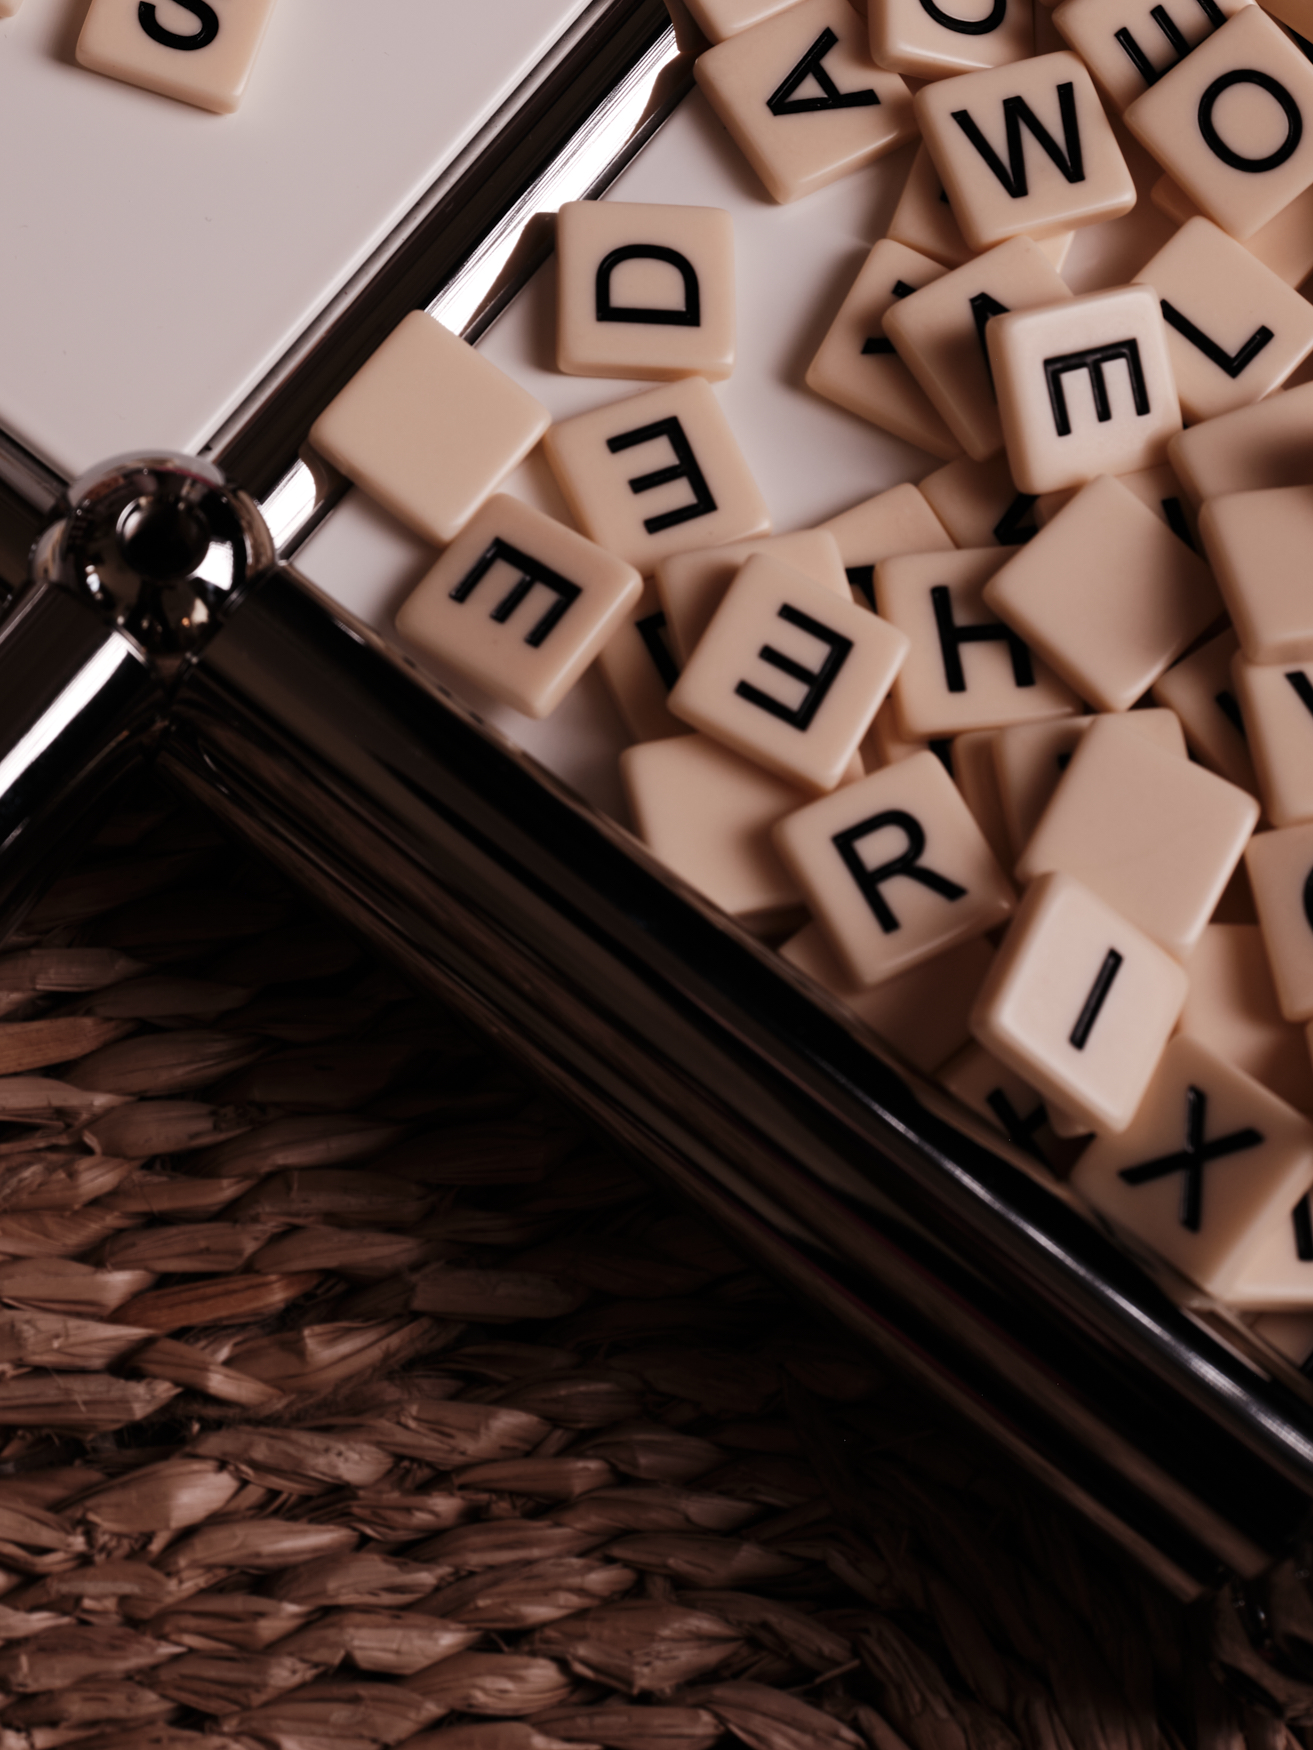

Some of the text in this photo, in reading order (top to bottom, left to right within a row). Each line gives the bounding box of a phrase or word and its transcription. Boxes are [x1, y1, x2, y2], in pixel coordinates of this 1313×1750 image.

[765, 26, 881, 117] A
[1196, 68, 1303, 173] O
[950, 81, 1086, 199] W
[595, 243, 701, 327] D
[1159, 299, 1275, 379] L
[1042, 337, 1151, 437] E
[606, 415, 718, 535] E
[448, 536, 583, 649] E
[733, 602, 854, 732] E
[830, 809, 969, 936] R
[1068, 947, 1123, 1051] I
[1118, 1084, 1266, 1233] X
